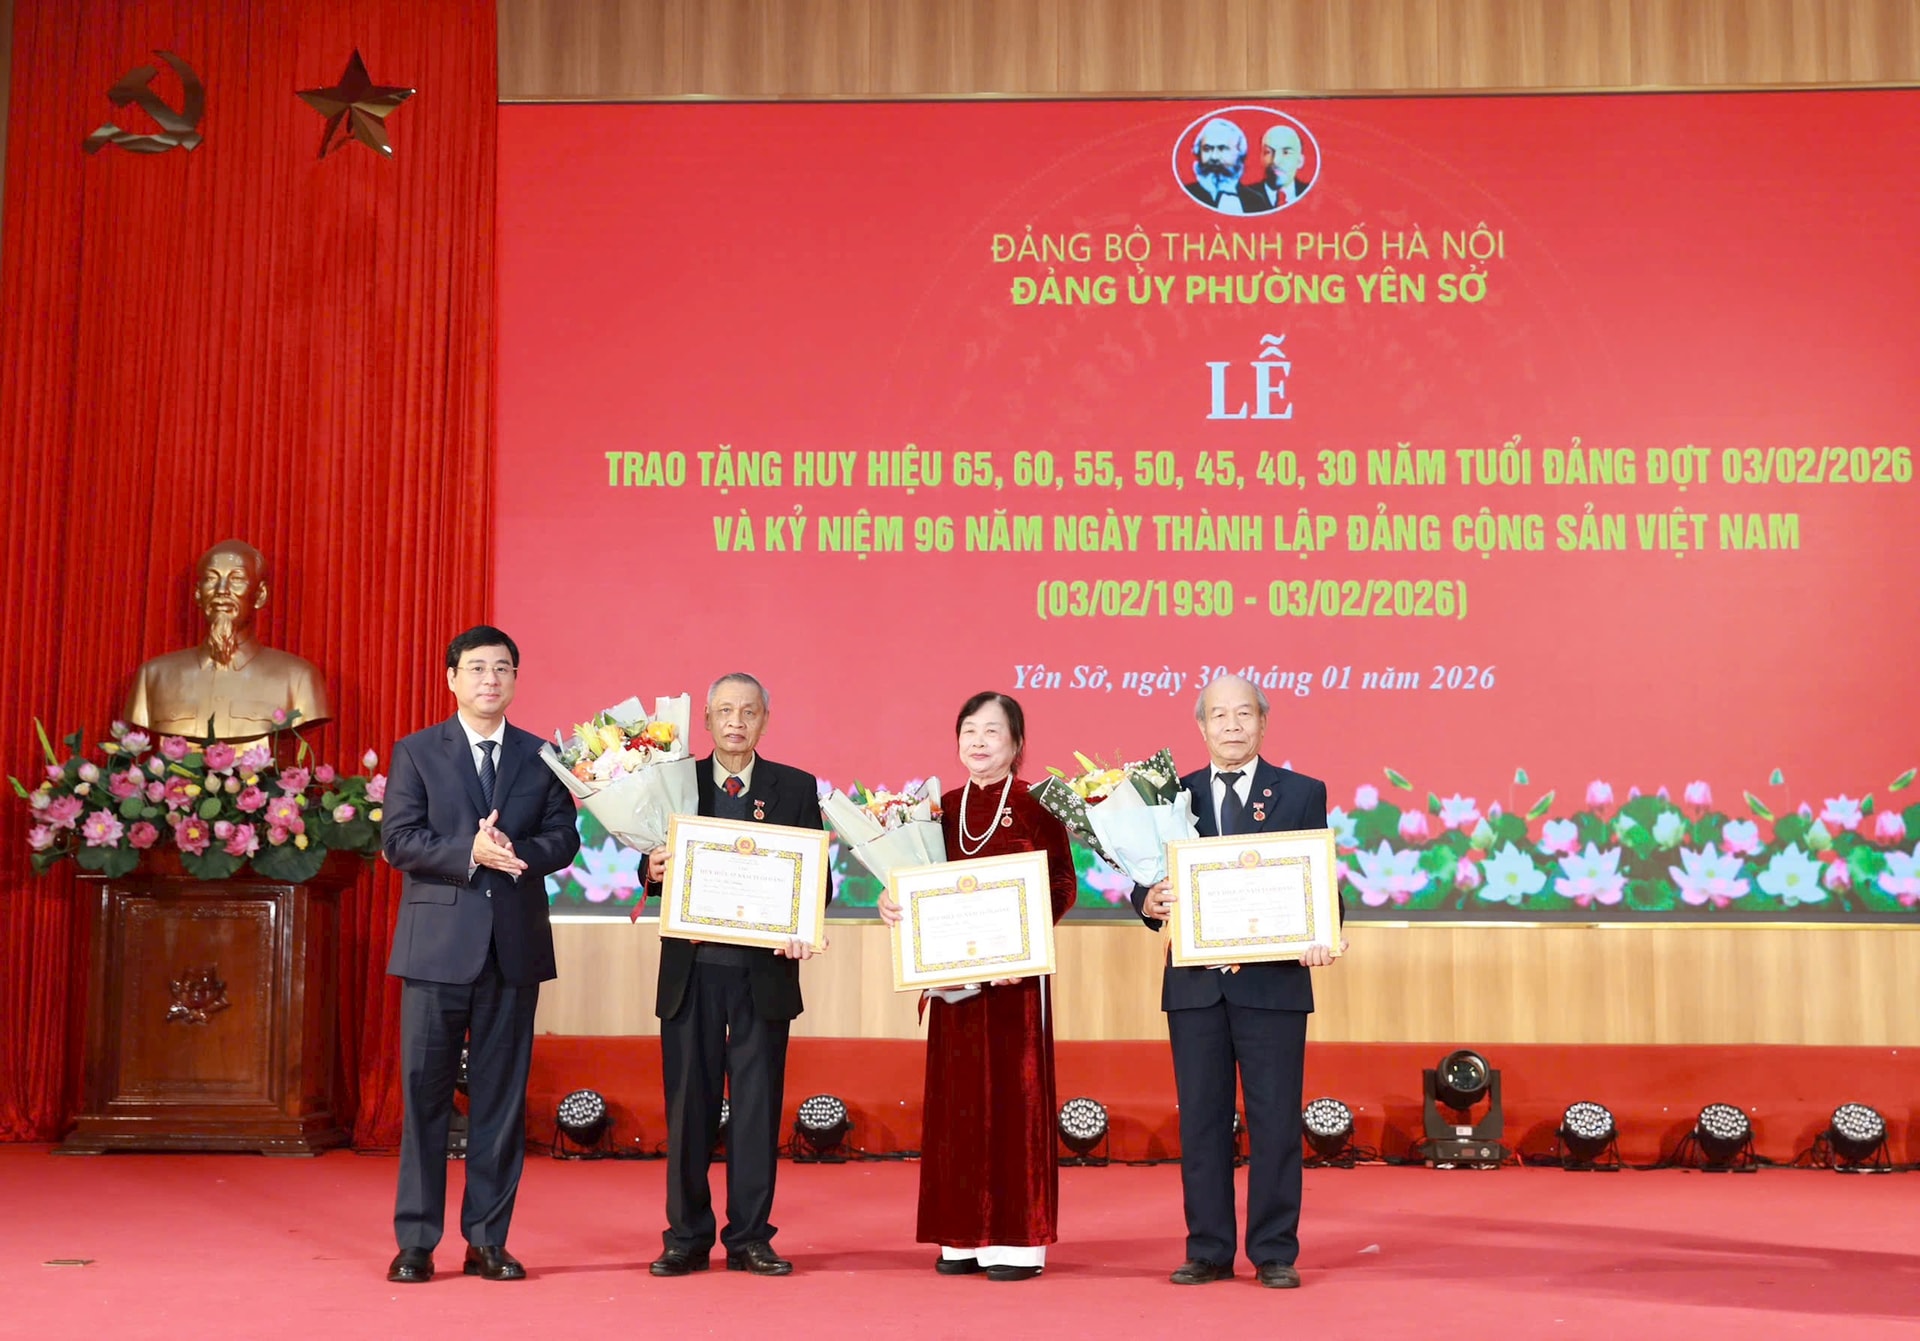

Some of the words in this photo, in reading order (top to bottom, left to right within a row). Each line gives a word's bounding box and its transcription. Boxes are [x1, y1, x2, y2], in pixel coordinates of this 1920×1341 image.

[991, 224, 1091, 262] ĐẢNG
[1105, 223, 1151, 270] BỘ
[1161, 223, 1283, 261] THÀNH
[1296, 222, 1369, 261] PHỐ
[1382, 222, 1430, 260] HÀ
[1443, 221, 1505, 265] NỘI
[1010, 267, 1117, 305] ĐẢNG
[1127, 263, 1176, 304] ỦY
[1186, 265, 1346, 304] PHƯỜNG
[1356, 265, 1426, 303] YÊN
[1438, 264, 1489, 303] SỞ
[1206, 333, 1293, 420] LỄ
[606, 451, 686, 487] TRAO
[698, 444, 782, 494] TẶNG
[794, 451, 857, 487] HUY
[867, 443, 942, 494] HIỆU
[953, 451, 1004, 490] 65,
[1013, 451, 1064, 490] 60,
[1074, 451, 1123, 490] 55,
[1135, 451, 1184, 490] 50,
[1195, 450, 1245, 490] 45,
[1256, 450, 1306, 490] 40,
[1317, 450, 1357, 487] 30
[1367, 442, 1447, 487] NĂM
[1456, 434, 1532, 486] TUỔI
[1542, 436, 1637, 485] ĐẢNG
[1646, 443, 1712, 492] ĐỢT
[1722, 446, 1914, 484] 03/02/2026
[713, 509, 756, 553] VÀ
[765, 504, 807, 552] KỶ
[818, 509, 904, 560] NIỆM
[914, 515, 955, 552] 96
[966, 508, 1043, 552] NĂM
[1054, 507, 1143, 552] NGÀY
[1153, 508, 1263, 552] THÀNH
[1275, 507, 1338, 560] LẬP
[1347, 503, 1442, 552] ĐẢNG
[1452, 506, 1546, 560] CỘNG
[1556, 502, 1627, 552] SẢN
[1636, 506, 1709, 559] VIỆT
[1719, 513, 1800, 550] NAM
[1036, 579, 1235, 621] (03/02/1930
[1245, 597, 1258, 606] -
[1268, 578, 1468, 621] 03/02/2026)
[1014, 664, 1063, 690] Yên
[1070, 663, 1114, 694] Sở,
[1121, 665, 1188, 697] ngày
[1321, 665, 1353, 690] 01
[1361, 666, 1421, 690] năm
[1429, 665, 1496, 690] 2026
